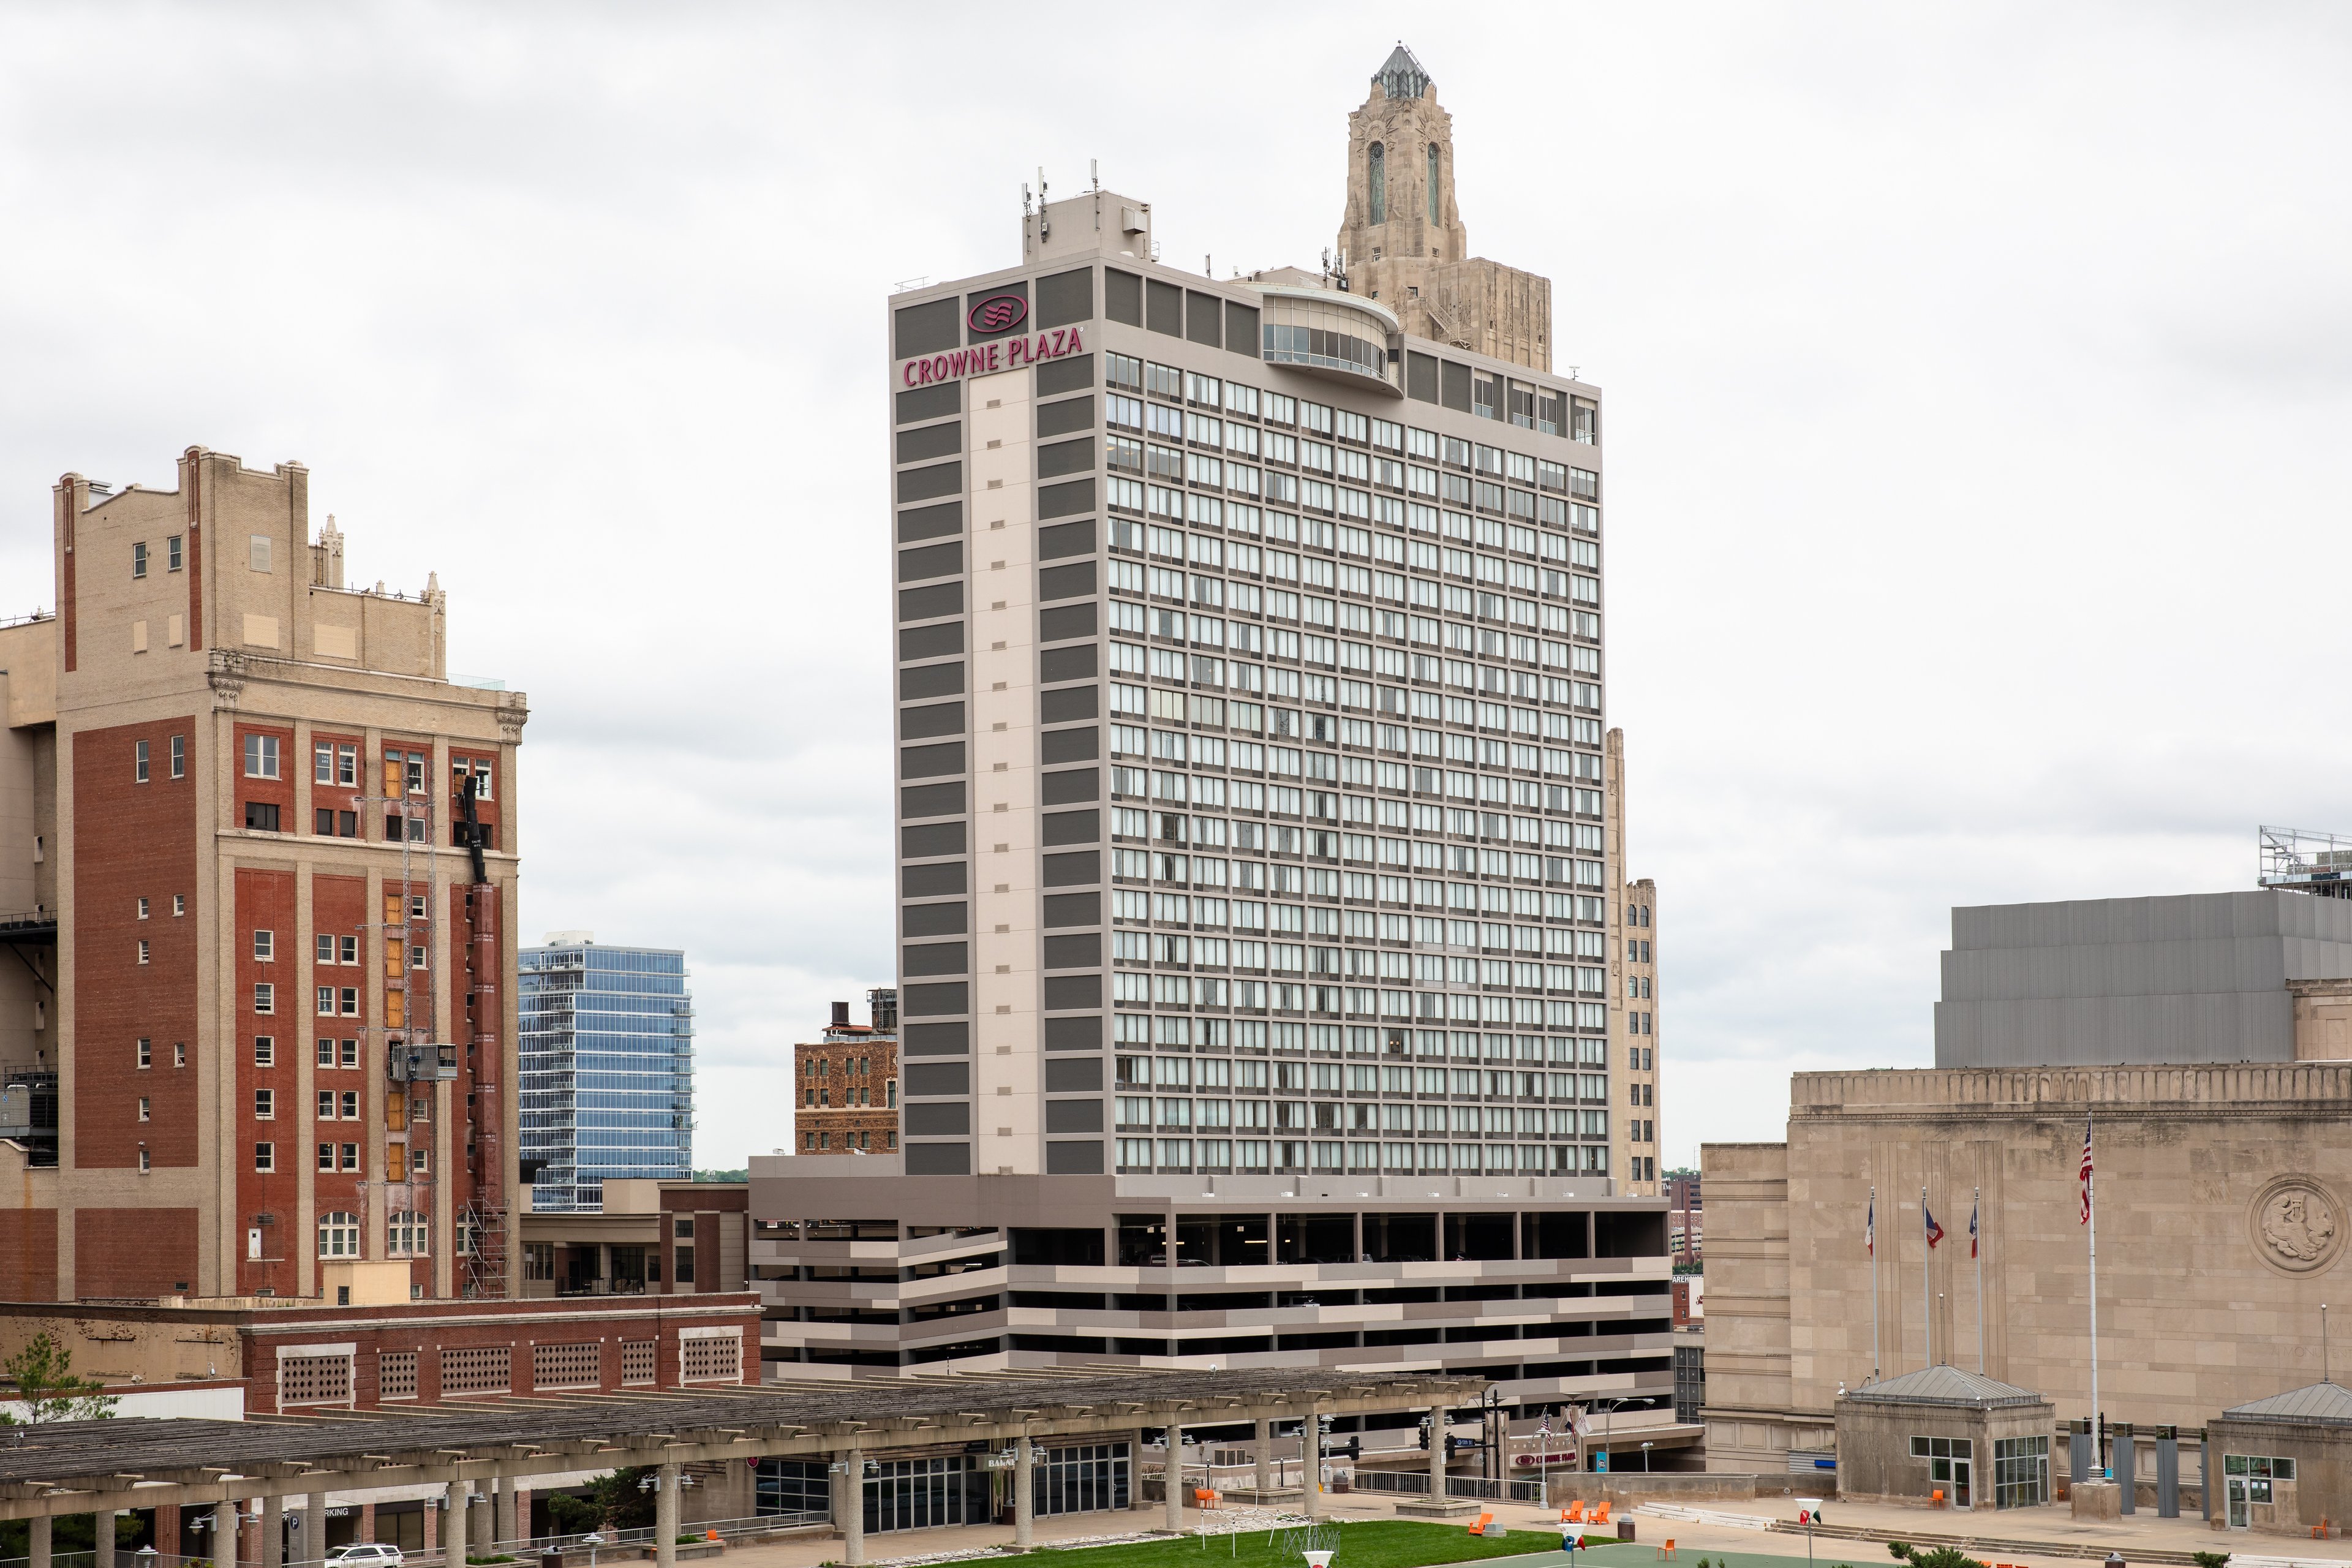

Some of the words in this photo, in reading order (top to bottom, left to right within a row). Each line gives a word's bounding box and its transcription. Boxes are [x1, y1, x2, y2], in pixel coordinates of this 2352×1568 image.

[903, 344, 998, 386] CROWNE
[1009, 327, 1082, 366] PLAZA
[988, 1458, 1016, 1467] BARNE
[325, 1507, 349, 1517] RKING
[292, 1518, 298, 1528] P
